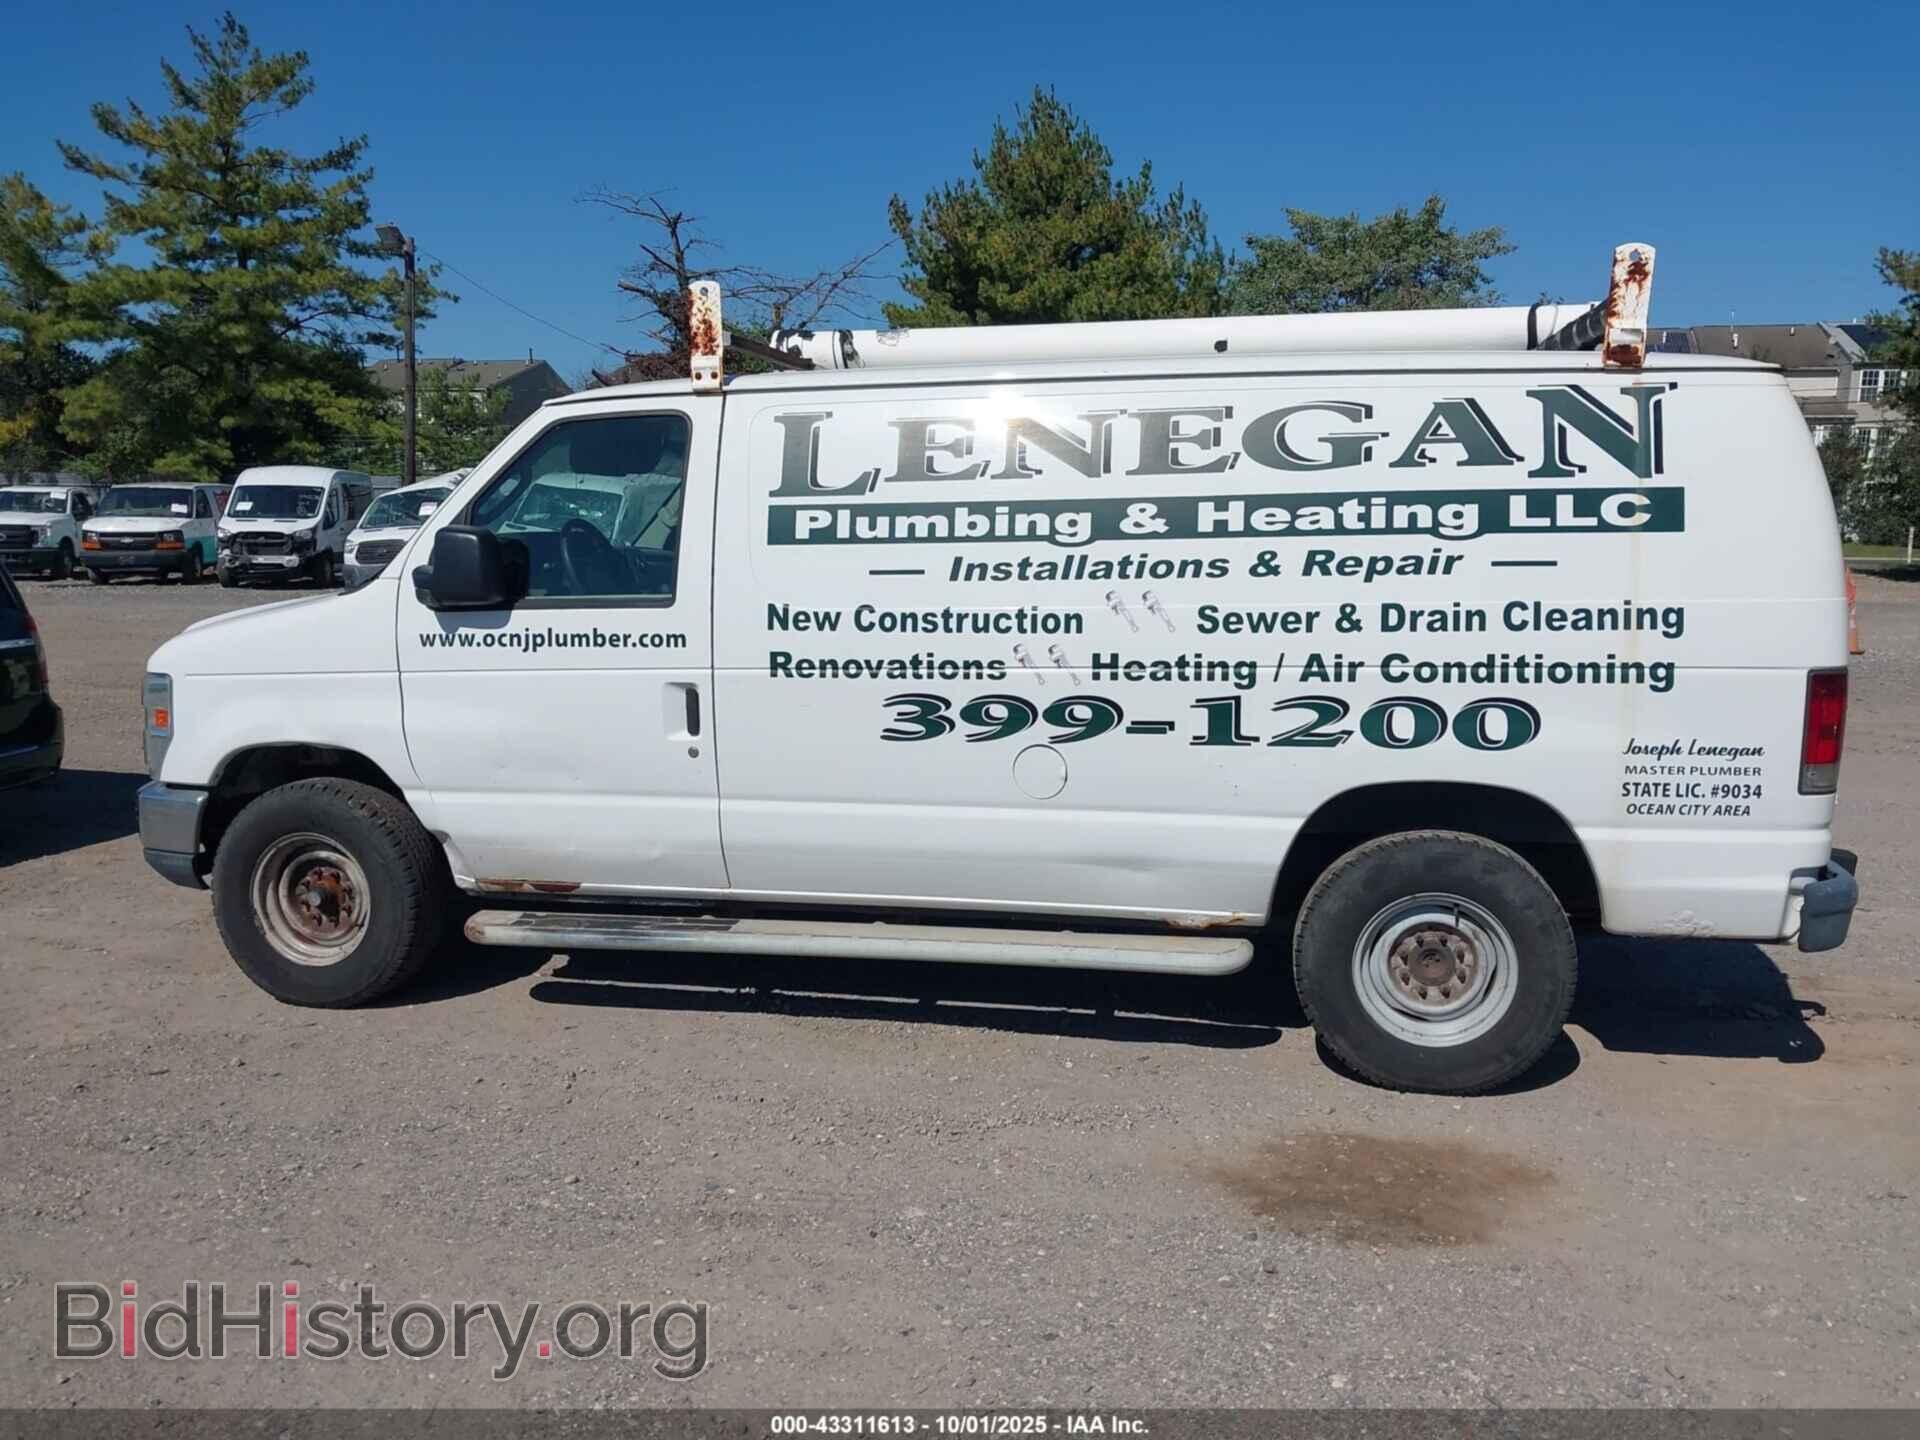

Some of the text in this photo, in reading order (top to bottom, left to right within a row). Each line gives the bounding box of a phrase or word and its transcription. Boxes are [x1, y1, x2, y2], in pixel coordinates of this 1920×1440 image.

[769, 382, 1678, 498] LENEGAN
[794, 493, 1652, 543] Plumbing & Heating LLC
[949, 548, 1464, 583] Installations & Repair
[767, 604, 1084, 634] New Construction
[1197, 600, 1685, 639] Sewer & Drain Cleaning
[419, 628, 687, 652] www.ocnjplumber.com
[769, 651, 1007, 681] Renovations
[1091, 652, 1676, 692] Heating / Air Conditioning
[880, 693, 1542, 751] 399-1200
[1622, 738, 1766, 761] Joseph Lenegan
[1624, 765, 1762, 776] MASTER PLUMBER
[1621, 782, 1763, 799] STATE LIC. #9034
[1626, 803, 1751, 817] OCEAN CITY AREA
